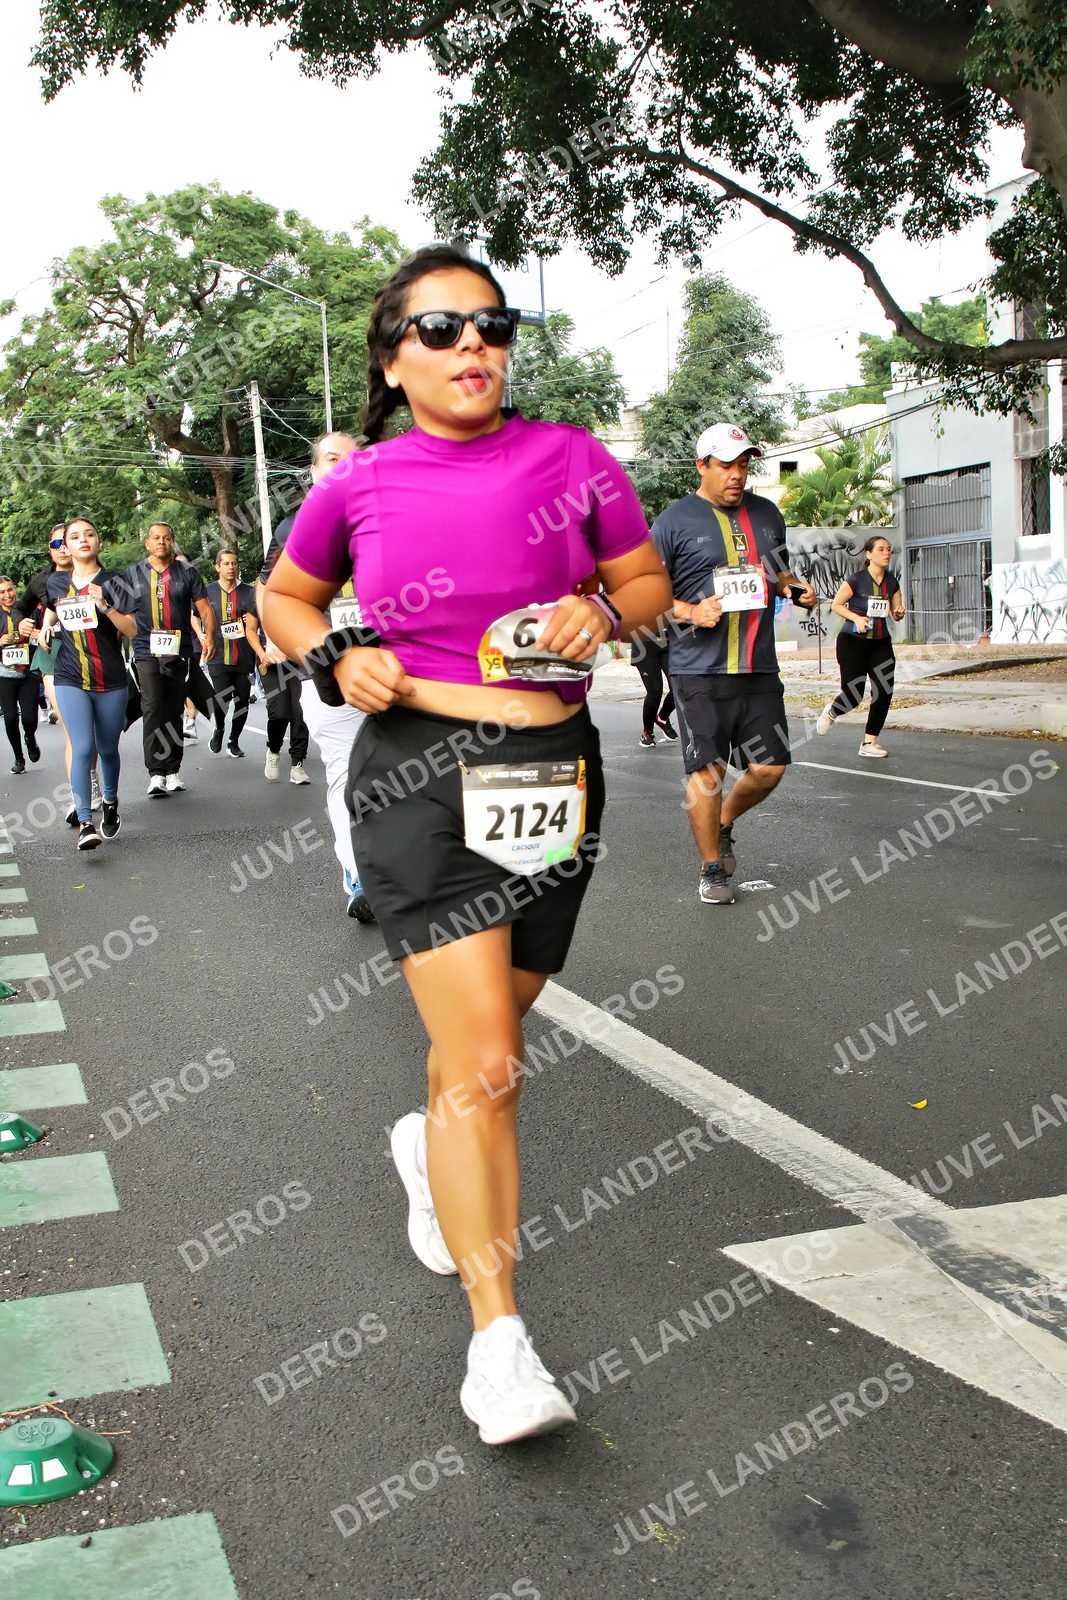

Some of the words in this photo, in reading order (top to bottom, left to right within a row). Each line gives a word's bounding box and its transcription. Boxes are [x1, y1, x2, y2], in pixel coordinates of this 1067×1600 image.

[722, 579, 757, 595] 8166
[871, 602, 887, 610] 4711
[62, 608, 88, 620] 2386
[224, 625, 239, 633] 4924
[157, 637, 173, 646] 377
[5, 650, 24, 659] 4717
[485, 799, 568, 842] 2124
